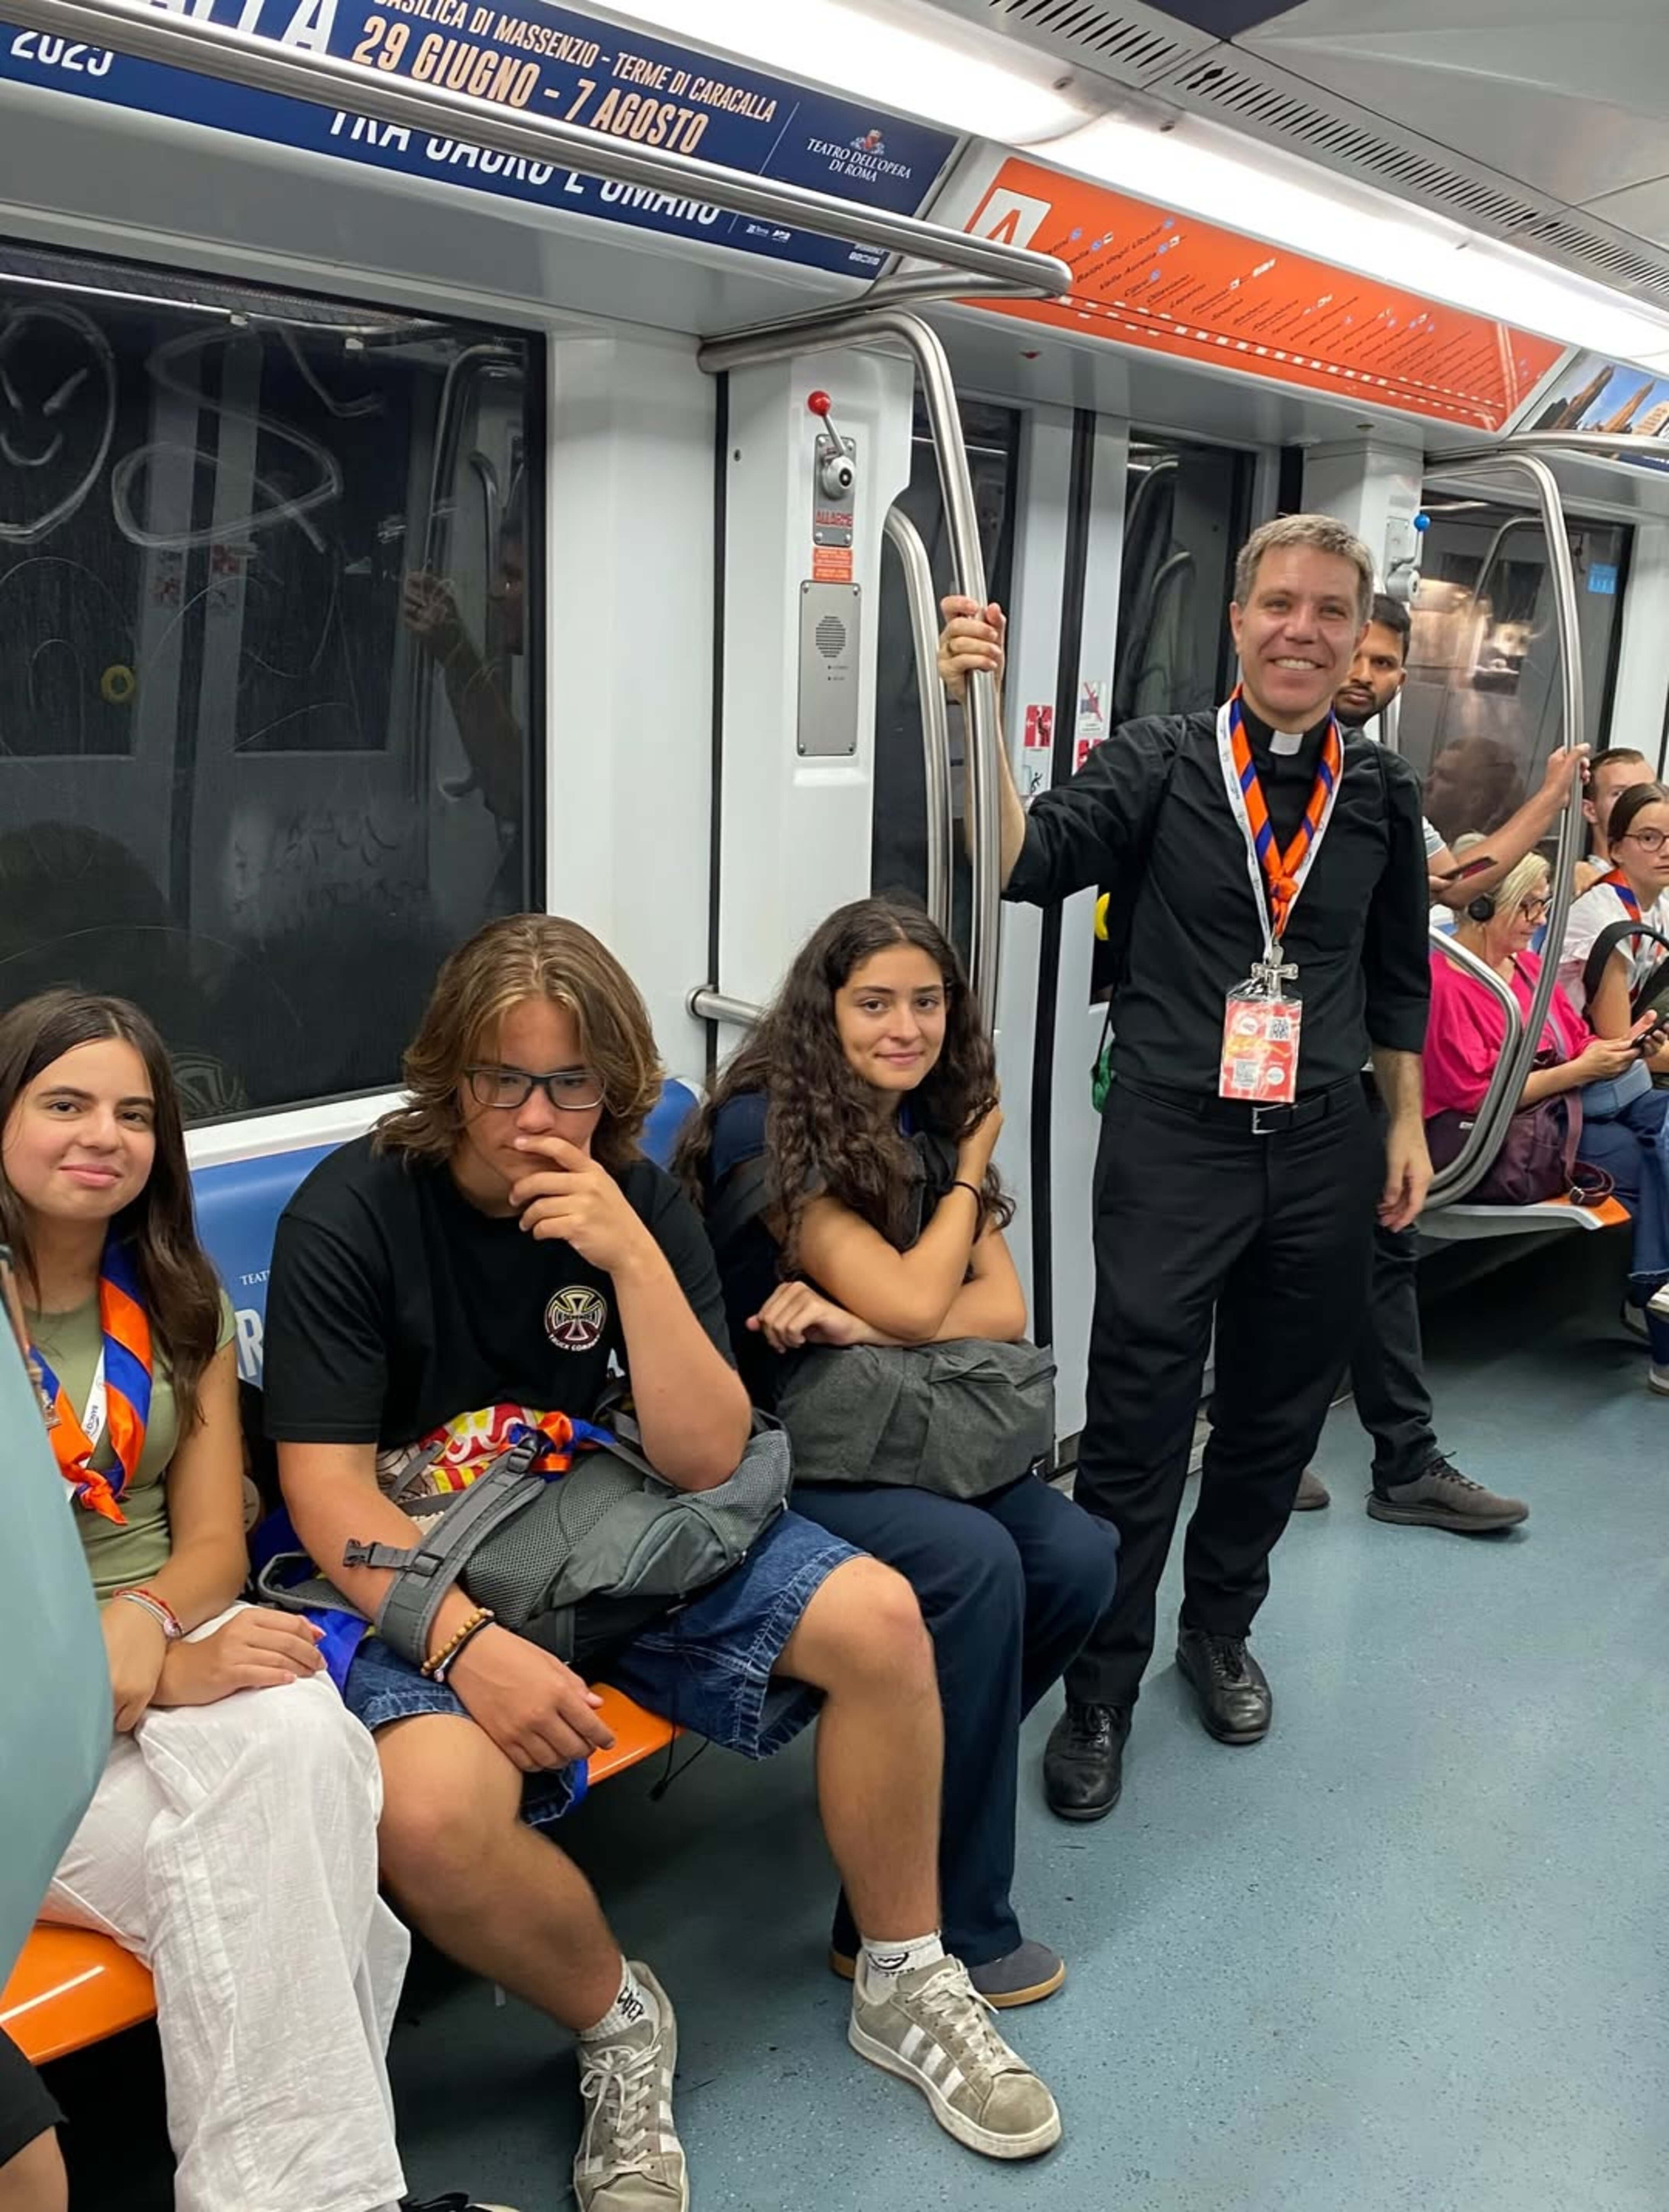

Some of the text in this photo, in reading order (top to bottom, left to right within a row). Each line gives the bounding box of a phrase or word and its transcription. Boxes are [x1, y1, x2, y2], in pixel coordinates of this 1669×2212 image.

[352, 15, 410, 71] 29
[411, 33, 540, 107] GIUGNO
[564, 78, 597, 121] 7
[589, 88, 709, 154] AGOSTO
[468, 7, 495, 36] DI
[493, 15, 600, 68] MASSENZIO
[612, 52, 672, 90] TERME
[668, 70, 692, 95] DI
[688, 77, 777, 123] CARACALLA
[807, 138, 911, 179] TEATRO DELL'OPERA
[828, 158, 877, 182] DI ROMA
